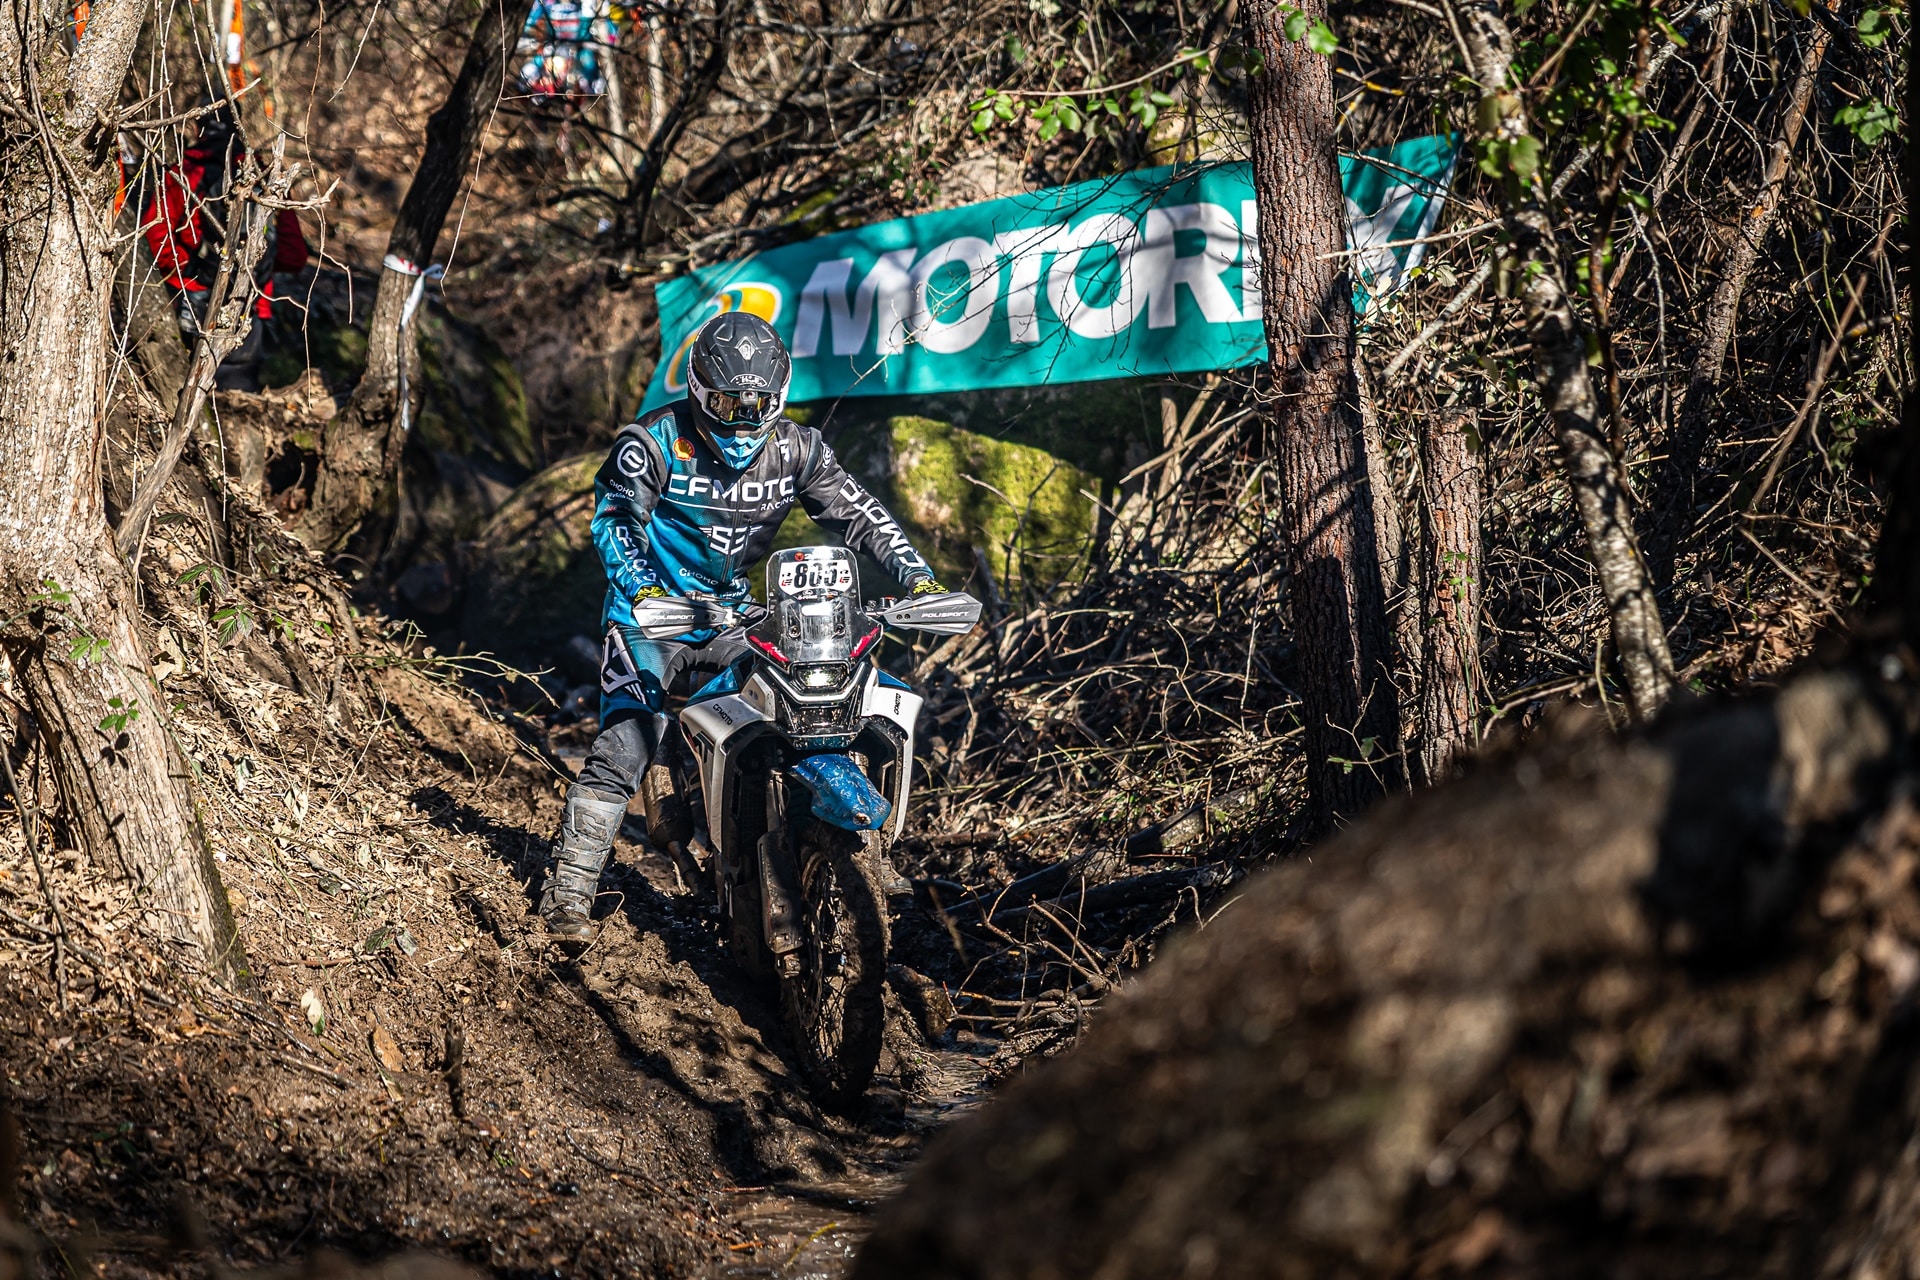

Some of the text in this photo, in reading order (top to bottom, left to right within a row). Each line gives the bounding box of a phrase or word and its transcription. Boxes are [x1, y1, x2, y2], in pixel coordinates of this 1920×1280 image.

[791, 182, 1421, 357] MOTORX
[921, 611, 970, 619] POLISPORT
[711, 703, 734, 726] CFMOTO
